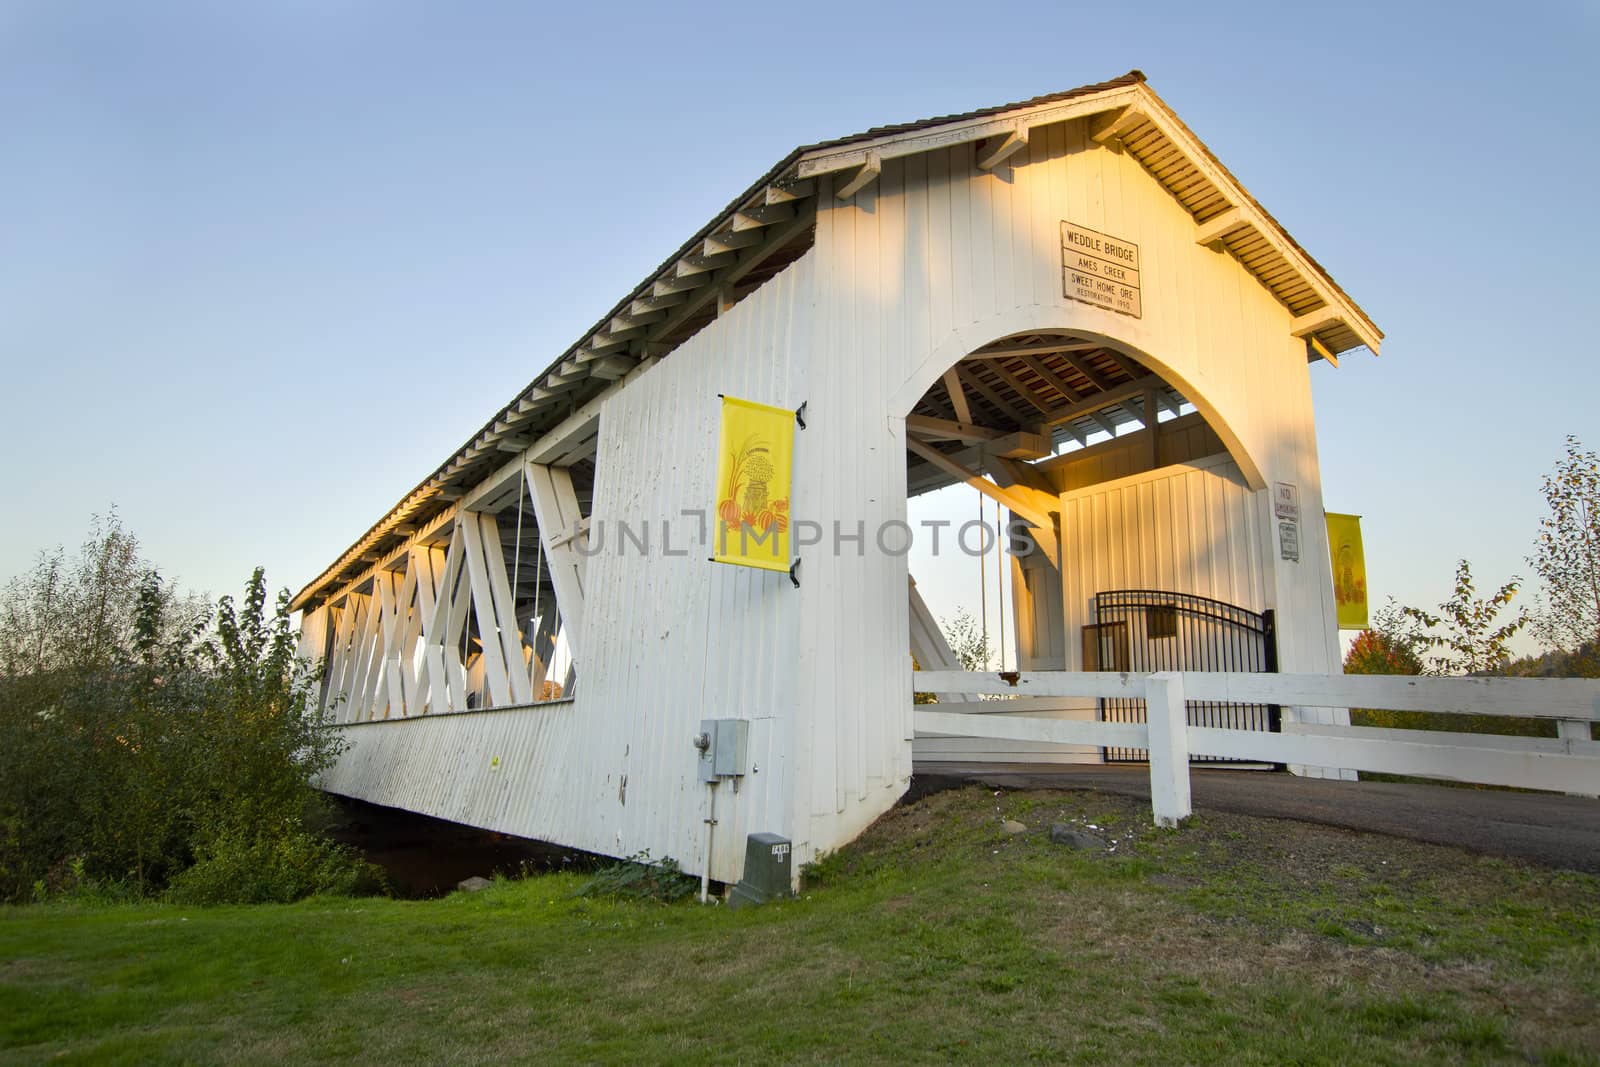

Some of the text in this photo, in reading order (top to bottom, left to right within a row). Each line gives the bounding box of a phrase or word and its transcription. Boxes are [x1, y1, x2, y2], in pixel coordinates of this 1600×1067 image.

[1067, 230, 1134, 262] WEDDLE BRIDGE
[1078, 258, 1126, 280] AMES CREEK
[1071, 273, 1133, 300] SWEET HOME ORE
[1077, 288, 1112, 304] RESTORATION
[1280, 487, 1291, 500] NO
